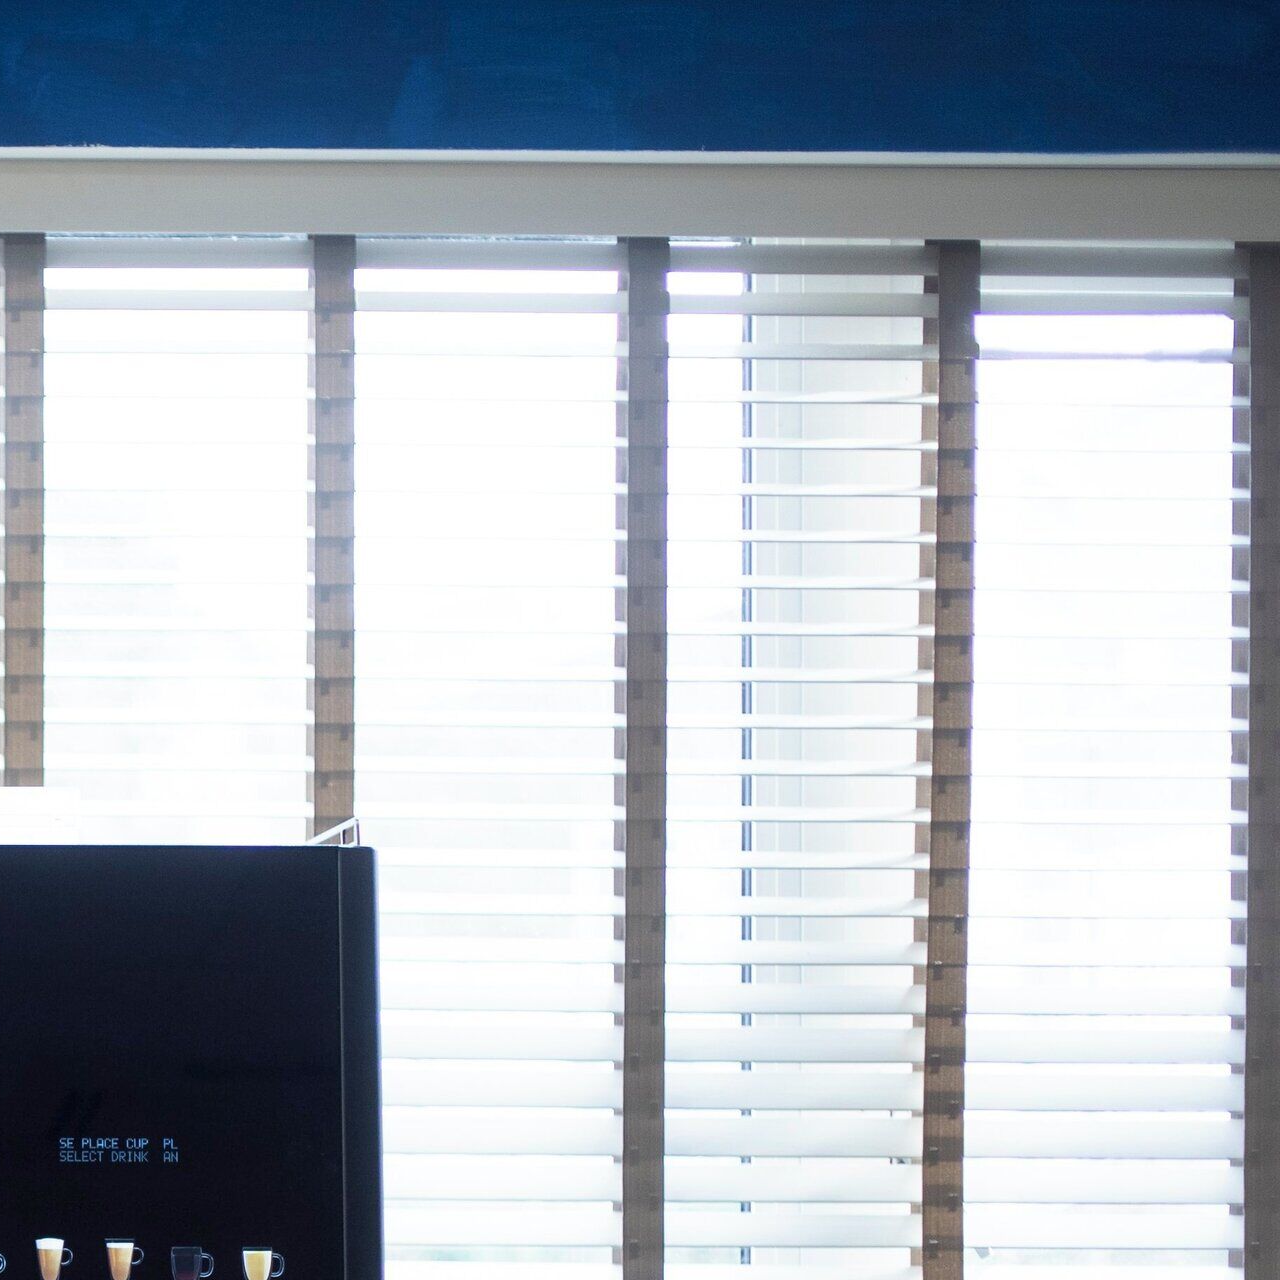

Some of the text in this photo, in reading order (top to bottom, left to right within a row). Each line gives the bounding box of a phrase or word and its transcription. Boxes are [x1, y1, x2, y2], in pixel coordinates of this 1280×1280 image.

[60, 1138, 178, 1149] SE PLACE CUP PL
[60, 1151, 178, 1162] SELECT DRINK AN
